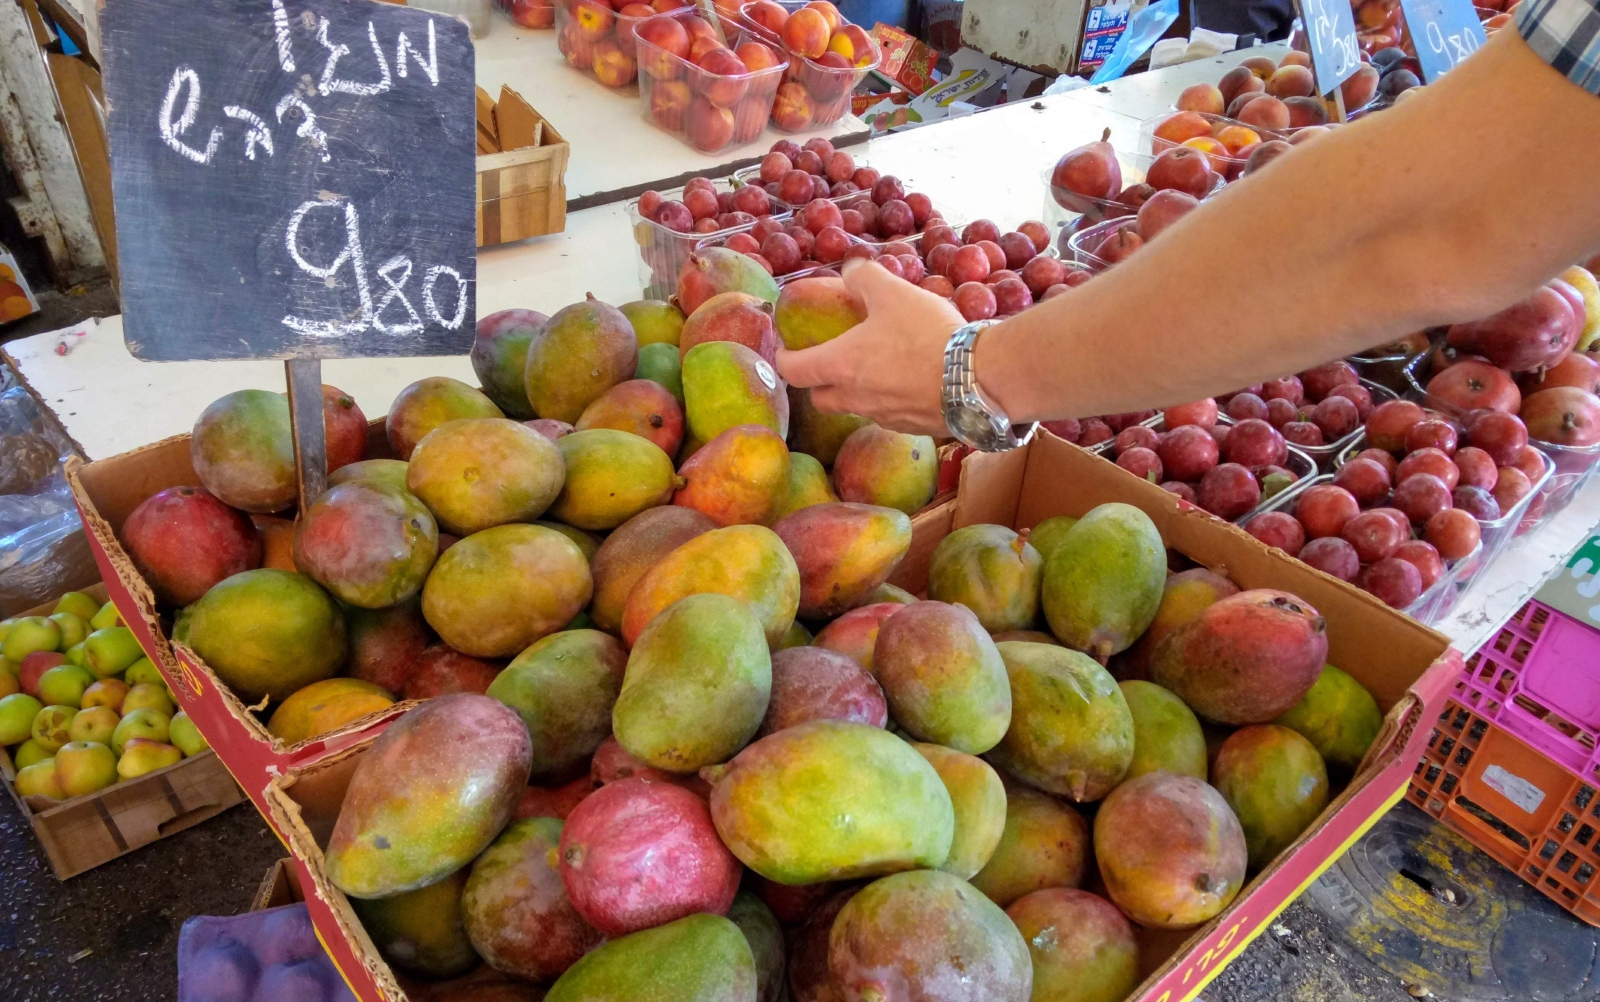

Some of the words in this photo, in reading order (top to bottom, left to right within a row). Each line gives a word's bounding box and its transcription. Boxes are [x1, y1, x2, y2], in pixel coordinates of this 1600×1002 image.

[1332, 14, 1361, 76] 580
[1426, 21, 1480, 75] 980
[930, 84, 961, 103] ישראל
[962, 68, 990, 90] פירות
